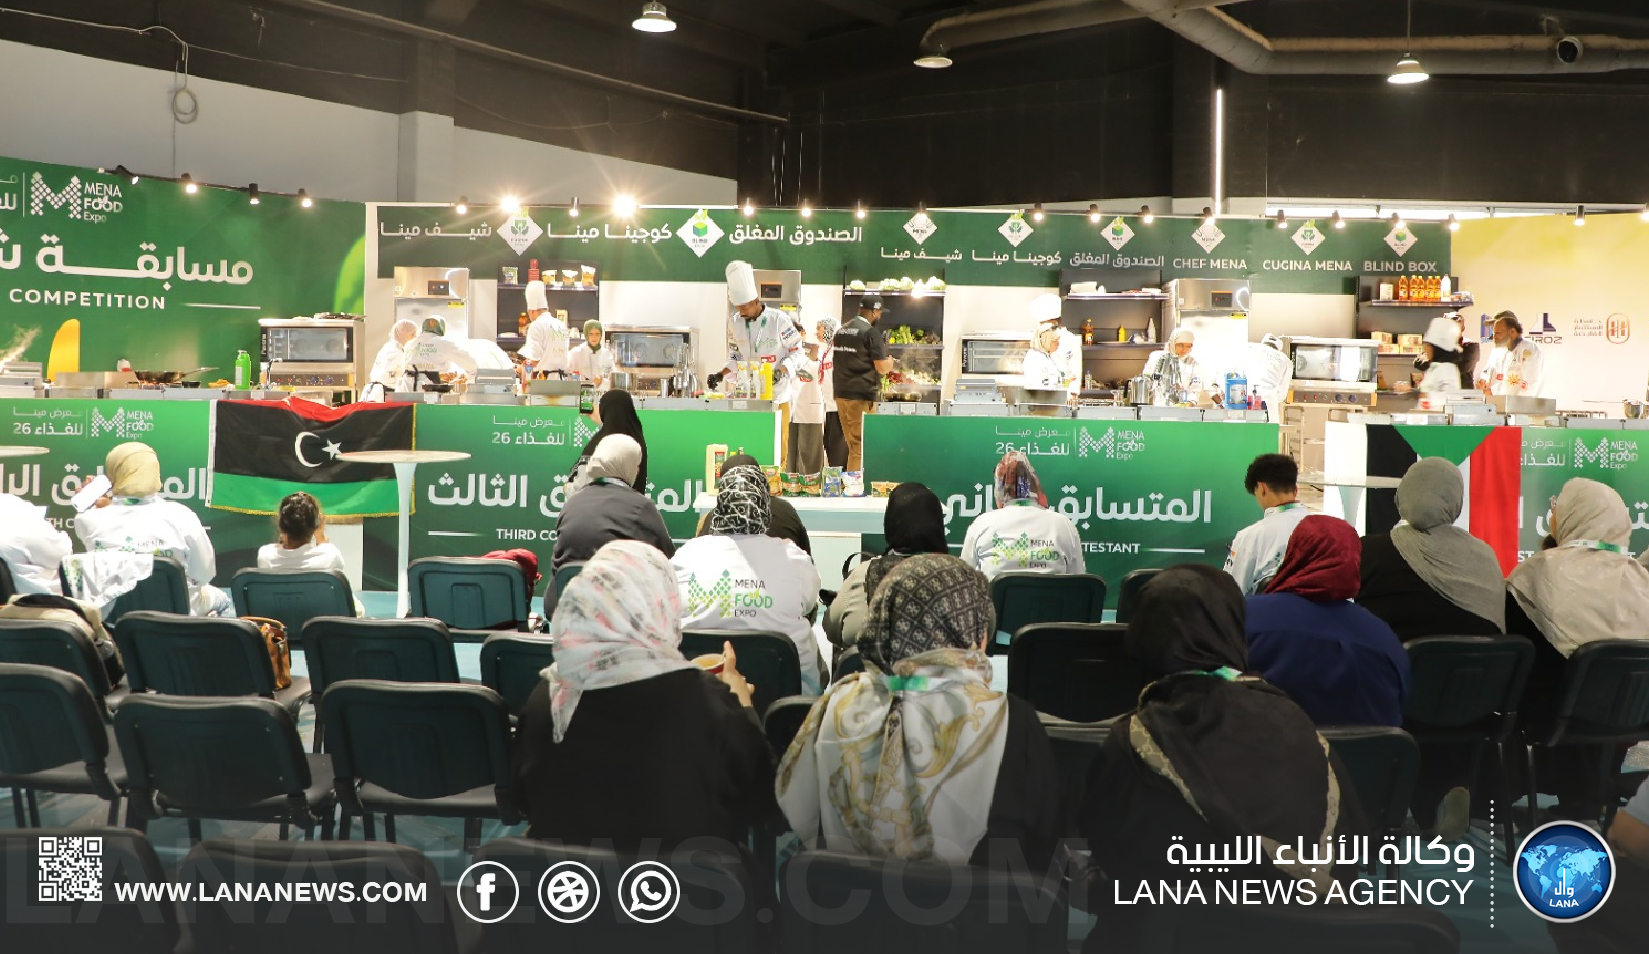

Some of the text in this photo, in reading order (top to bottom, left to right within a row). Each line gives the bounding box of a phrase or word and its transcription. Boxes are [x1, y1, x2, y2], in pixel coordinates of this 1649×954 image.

[84, 181, 123, 198] MENA
[83, 196, 123, 213] FOOD
[83, 211, 107, 223] Expo
[380, 222, 492, 240] شيف مينا
[547, 223, 672, 244] كوجينا مينا
[728, 224, 862, 245] الصندوق المغلق
[881, 247, 963, 264] شيف مينا
[972, 249, 1062, 266] كوجينا مينا
[1069, 253, 1164, 268] الصندوق المغلق
[36, 234, 254, 291] مسابقة
[1173, 258, 1248, 269] CHEF MENA
[1262, 259, 1353, 271] CUGINA MENA
[1363, 260, 1438, 272] BLIND BOX
[9, 288, 165, 309] COMPETITION
[13, 406, 47, 419] مينا
[126, 410, 154, 421] MENA
[126, 420, 154, 432] FOOD
[493, 415, 528, 427] مينا
[13, 422, 84, 436] للغذاء 26
[995, 425, 1031, 438] مينا
[1117, 430, 1145, 441] MENA
[491, 431, 565, 446] للغذاء 26
[1116, 441, 1145, 452] FOOD
[1610, 441, 1638, 451] MENA
[1610, 450, 1638, 462] FOOD
[428, 472, 529, 508] الثالث
[496, 528, 537, 541] THIRD
[1030, 539, 1055, 548] MENA
[1030, 548, 1060, 561] FOOD
[734, 578, 766, 590] MENA
[734, 590, 773, 609] FOOD
[734, 608, 757, 618] EXPO
